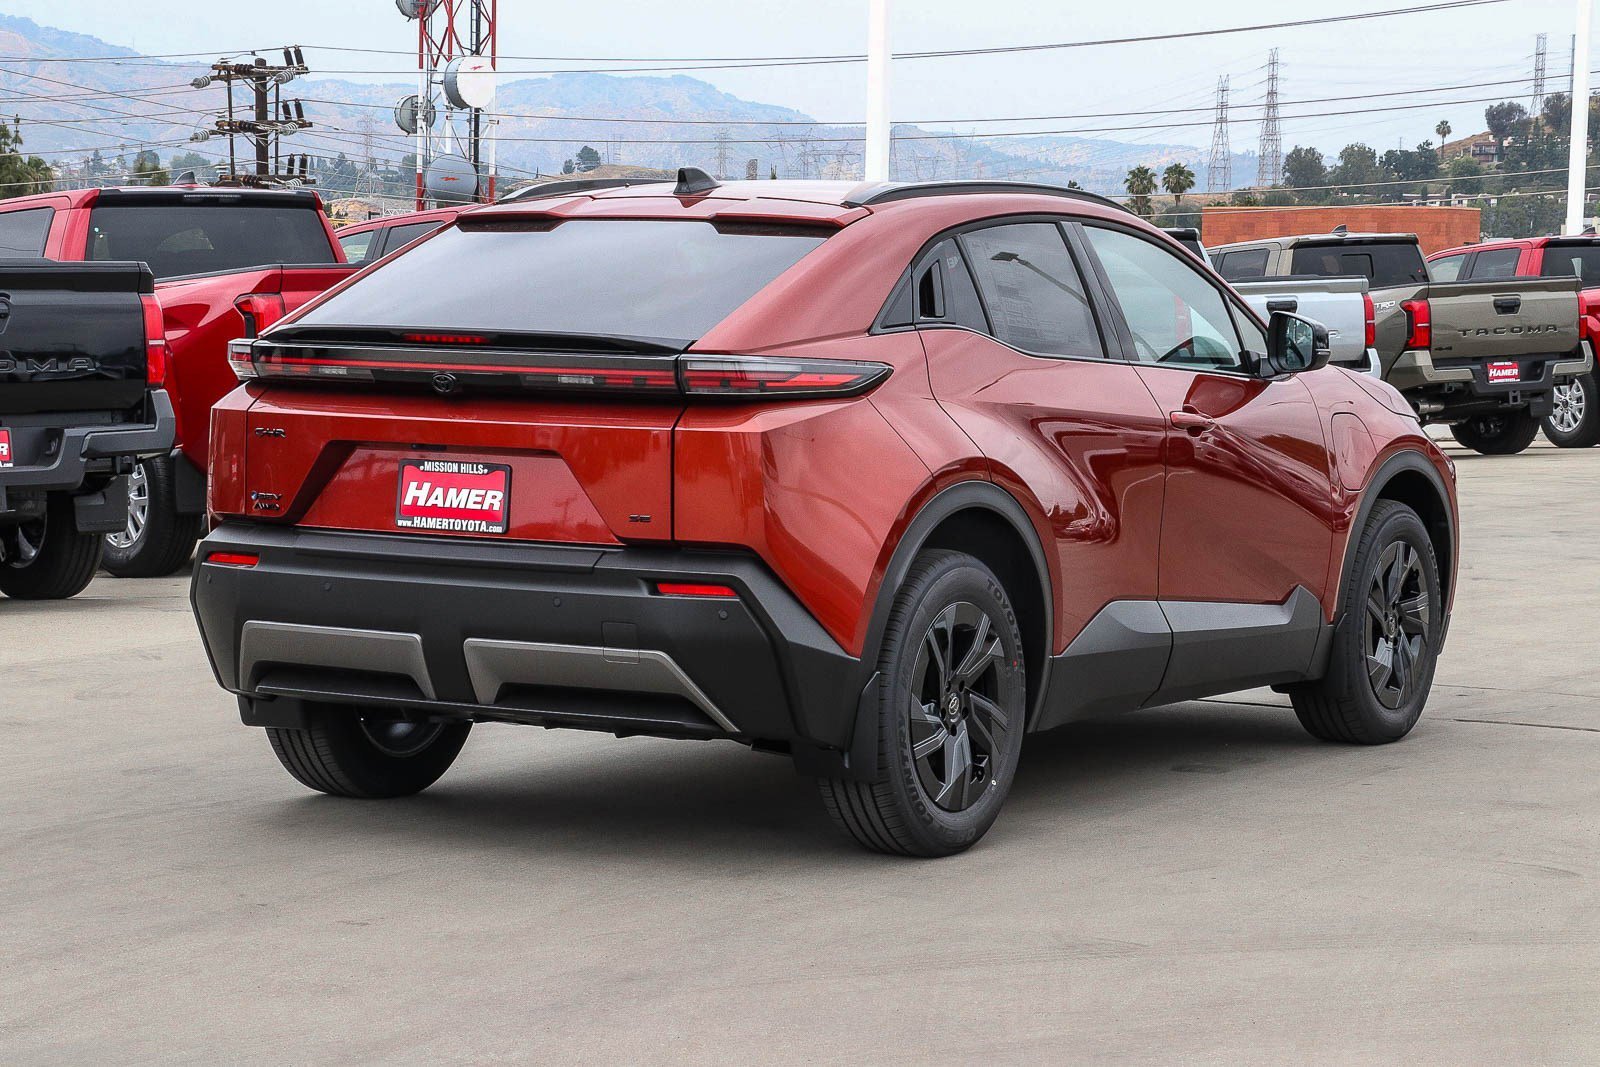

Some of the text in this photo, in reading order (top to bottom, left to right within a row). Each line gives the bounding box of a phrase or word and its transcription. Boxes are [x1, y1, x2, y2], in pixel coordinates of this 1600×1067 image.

[1457, 324, 1559, 338] TACOMA
[1489, 368, 1518, 377] HAMER
[424, 461, 483, 474] MISSION HILLS
[403, 481, 503, 511] HAMER
[397, 516, 503, 533] www.HAMERTOYOTA.com
